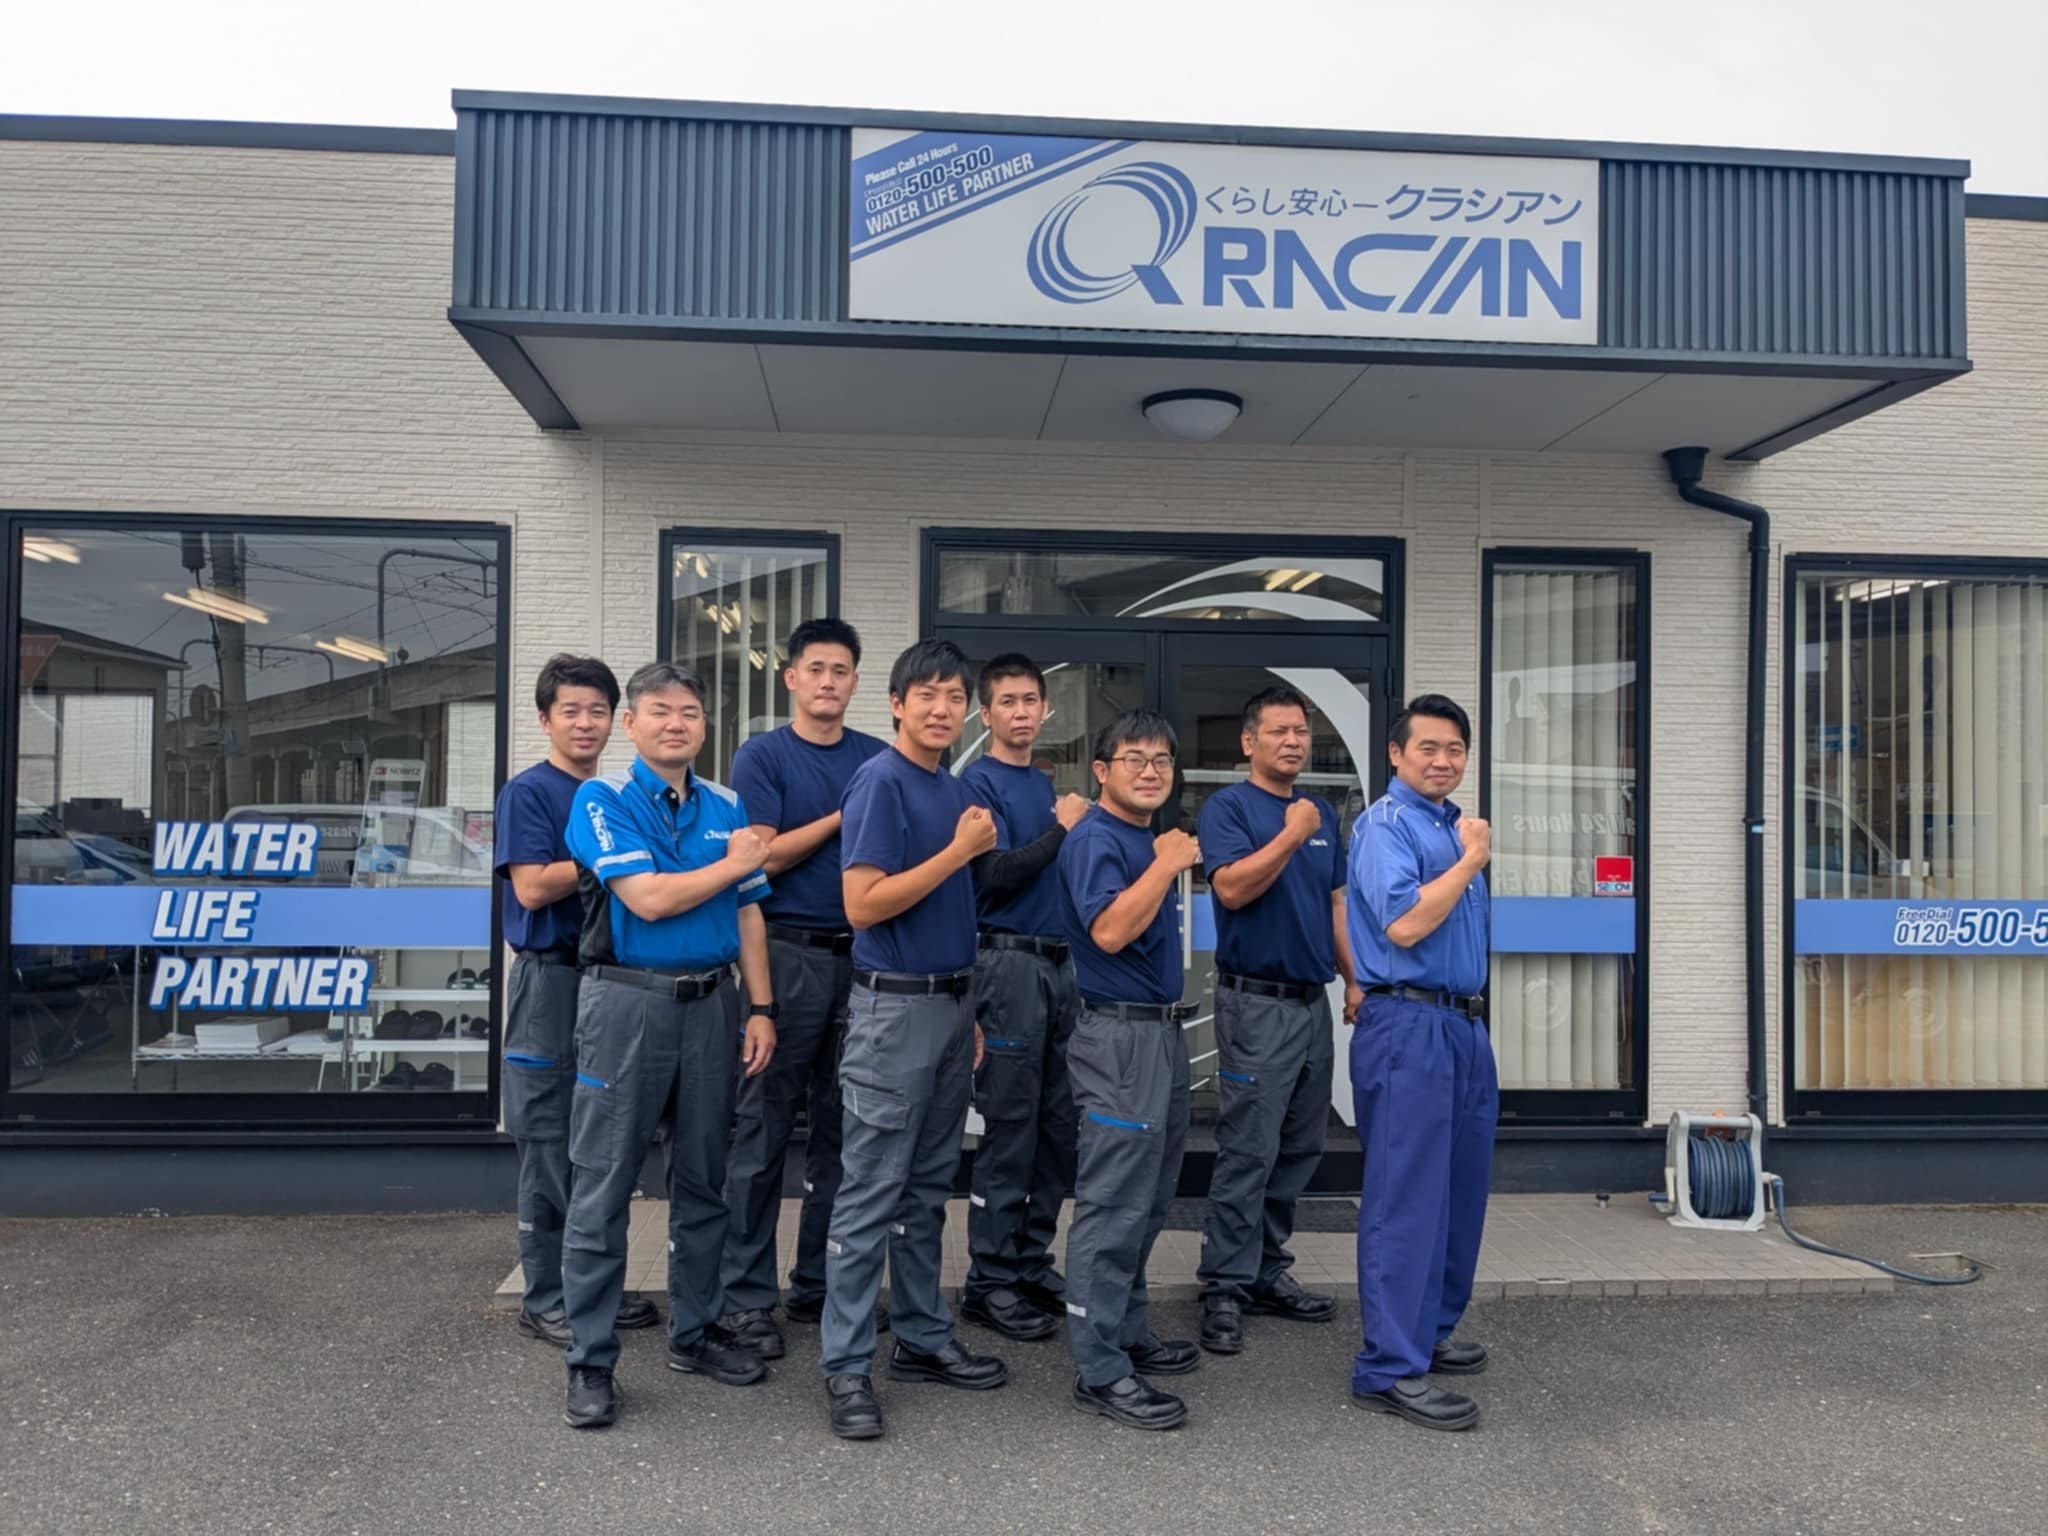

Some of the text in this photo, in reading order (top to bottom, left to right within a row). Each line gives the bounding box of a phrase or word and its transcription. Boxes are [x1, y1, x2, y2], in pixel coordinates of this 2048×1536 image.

[864, 166, 897, 186] Please
[897, 157, 917, 174] Call
[917, 153, 930, 166] 24
[931, 142, 959, 161] Hours
[866, 144, 994, 213] 0120-500-500
[865, 200, 921, 235] WATER
[923, 183, 960, 214] LIFE
[962, 152, 1035, 197] PARTNER
[151, 820, 319, 877] WATER
[151, 888, 260, 942] LIFE
[1897, 906, 1953, 921] FreeDial
[150, 955, 374, 1012] PARTNER
